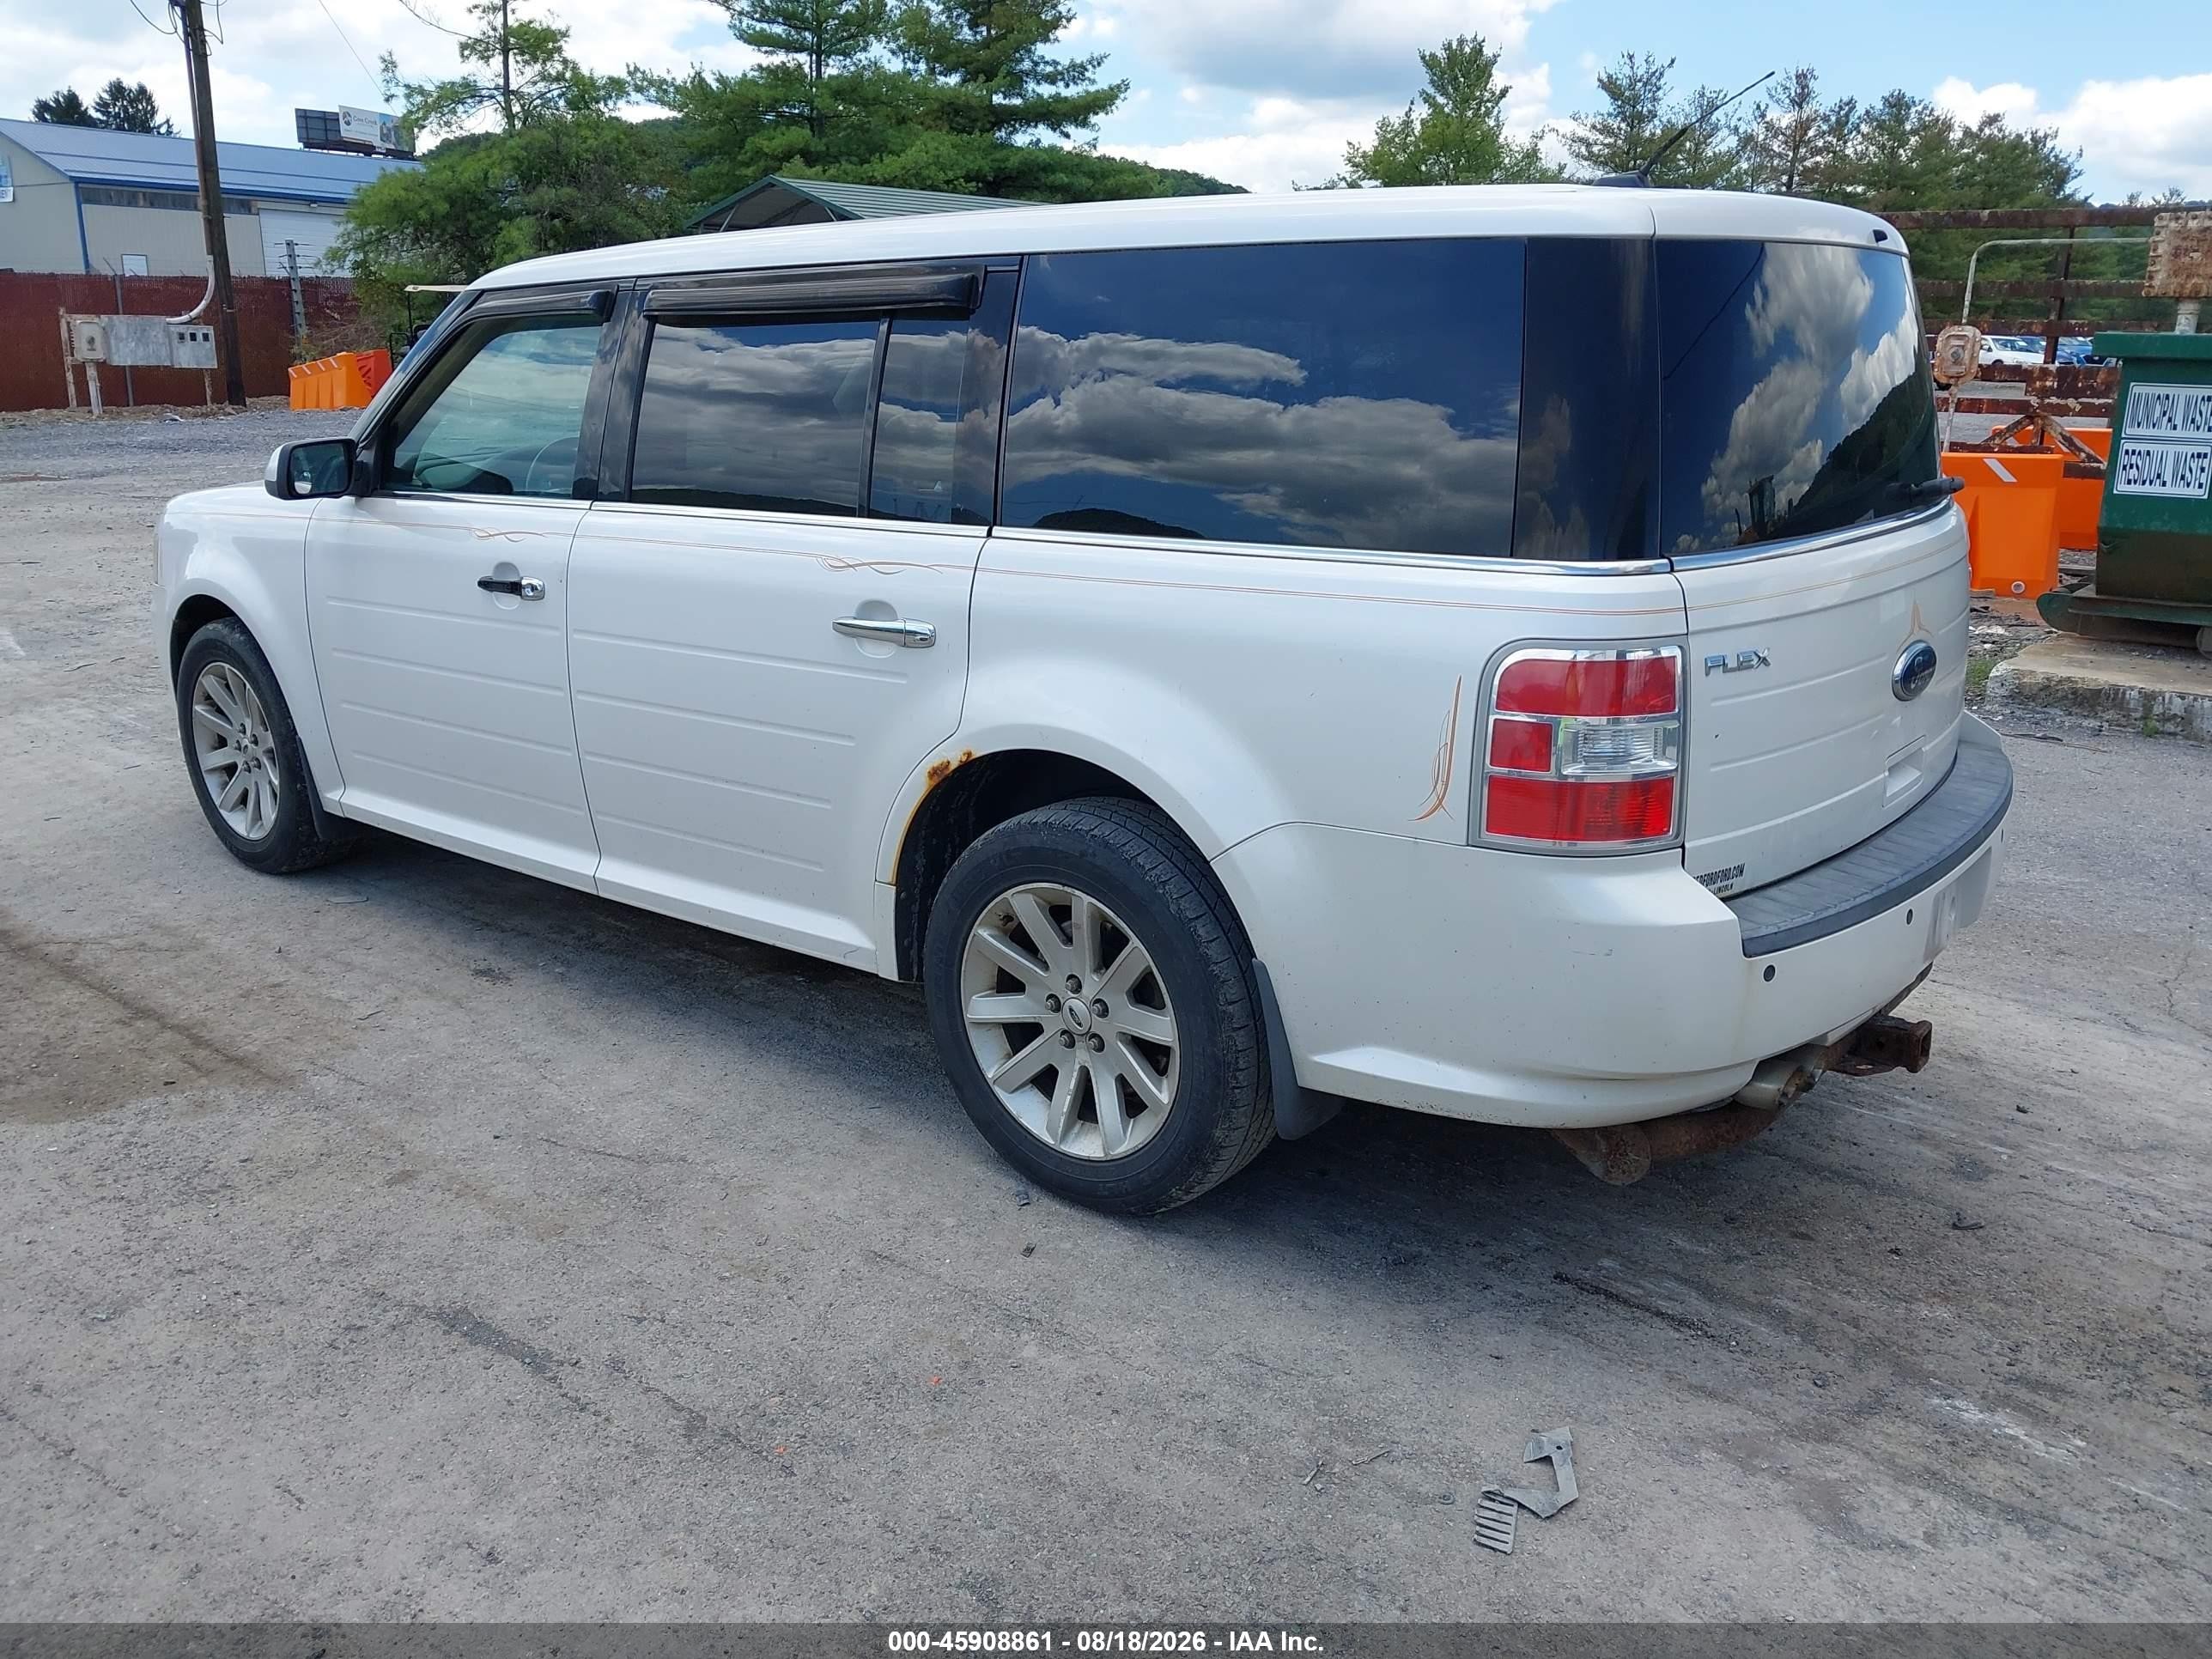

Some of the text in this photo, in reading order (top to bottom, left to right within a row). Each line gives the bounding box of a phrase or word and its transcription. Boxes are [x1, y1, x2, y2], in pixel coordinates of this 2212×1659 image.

[2129, 392, 2180, 431] MUNICIPAL
[2119, 448, 2209, 489] RESIDUAL WASTE
[1704, 647, 1771, 678] FLEX
